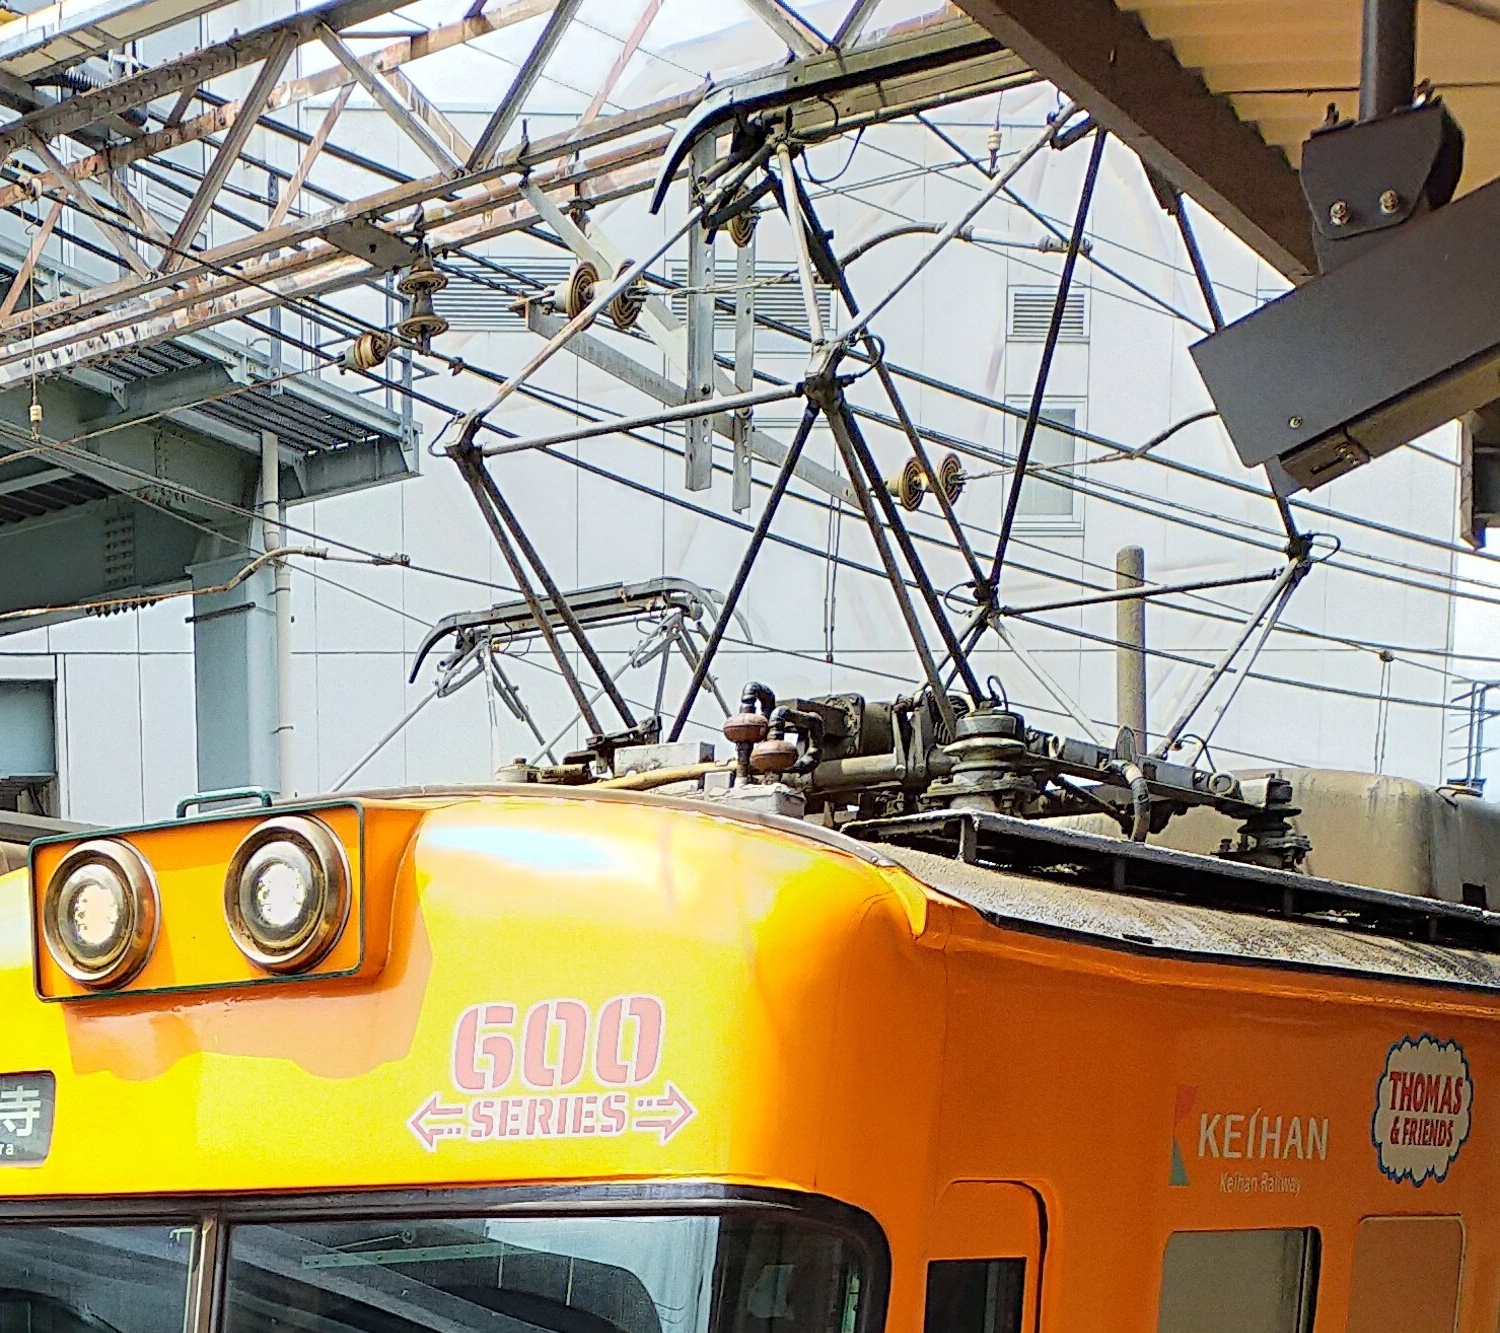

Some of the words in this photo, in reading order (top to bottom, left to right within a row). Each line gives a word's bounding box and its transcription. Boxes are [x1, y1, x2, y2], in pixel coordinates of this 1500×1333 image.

[453, 995, 663, 1091] 600
[1389, 1071, 1463, 1115] THOMAS
[470, 1094, 626, 1138] SERIES
[1199, 1107, 1328, 1160] KEIHAN
[1390, 1116, 1400, 1145] &
[1402, 1117, 1454, 1147] FRIENDS
[1220, 1171, 1258, 1194] Keihan
[1260, 1170, 1301, 1197] Railway
